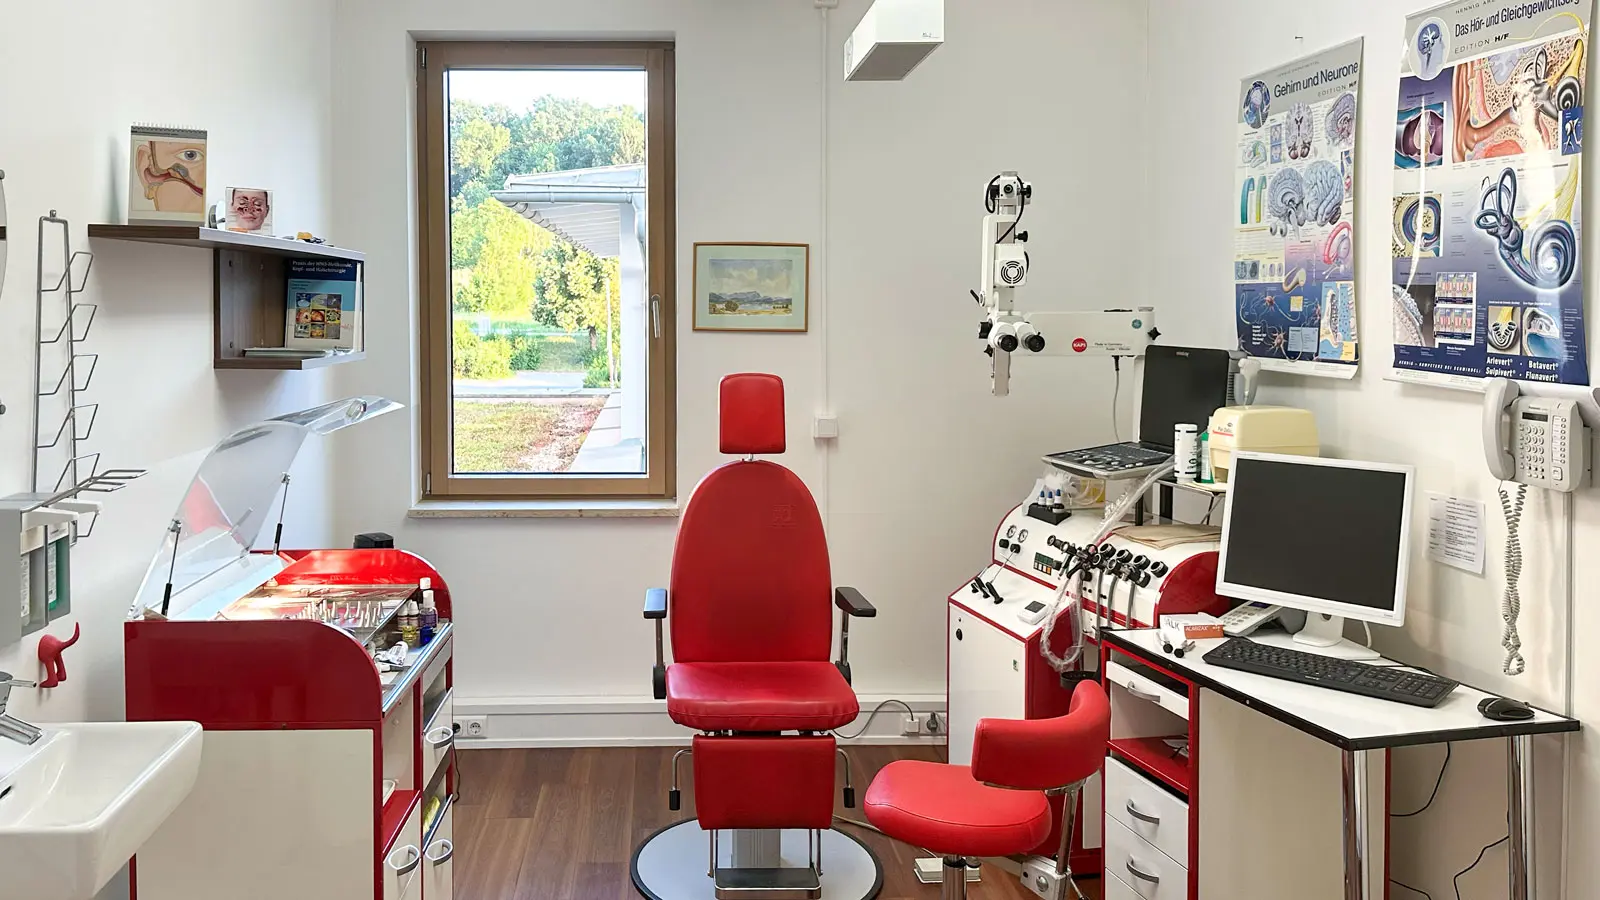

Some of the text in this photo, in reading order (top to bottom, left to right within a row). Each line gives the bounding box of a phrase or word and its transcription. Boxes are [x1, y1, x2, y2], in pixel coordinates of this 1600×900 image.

[1455, 0, 1580, 37] Das Hör- und Gleichgewichts
[1454, 33, 1510, 54] EDITION H/F
[1274, 80, 1302, 98] Gehirn
[1302, 72, 1319, 89] und
[1320, 62, 1359, 84] Neurone
